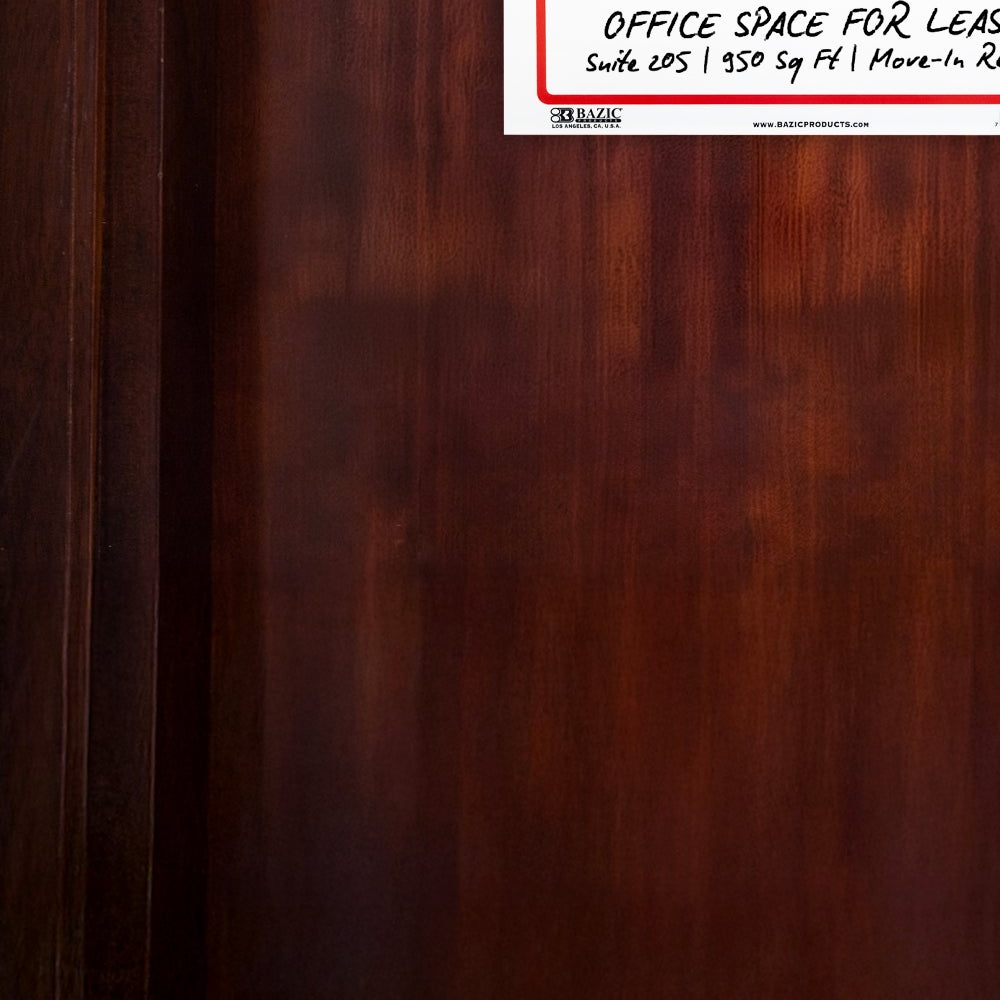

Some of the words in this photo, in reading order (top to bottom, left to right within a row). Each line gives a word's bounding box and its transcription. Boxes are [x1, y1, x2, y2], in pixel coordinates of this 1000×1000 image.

[605, 10, 721, 39] OFFICE
[735, 6, 829, 40] SPACE
[843, 0, 910, 39] FOR
[586, 49, 640, 72] Suite
[649, 51, 691, 73] 205
[723, 51, 764, 73] 950
[776, 51, 804, 84] Sq
[814, 46, 844, 70] Ft
[869, 48, 964, 70] Move-In
[577, 108, 622, 119] BAZIC
